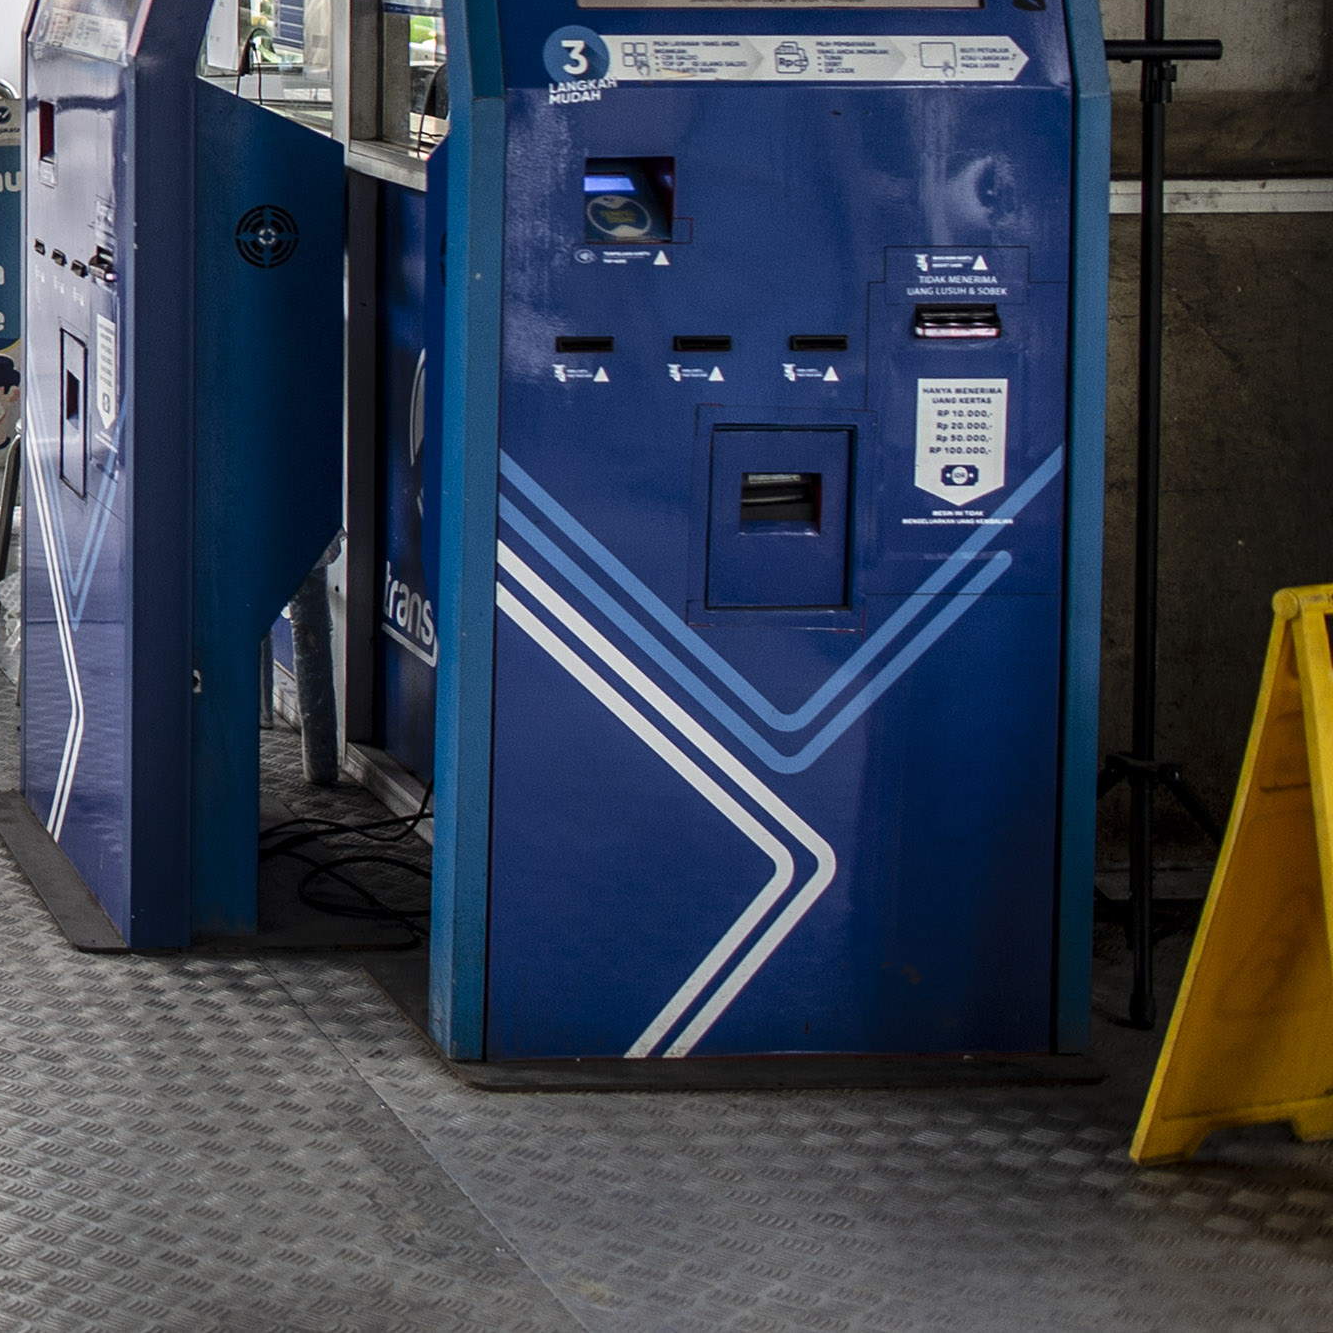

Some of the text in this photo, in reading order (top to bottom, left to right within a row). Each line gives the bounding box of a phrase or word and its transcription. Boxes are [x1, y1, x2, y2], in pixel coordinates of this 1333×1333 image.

[561, 40, 589, 75] 3
[548, 77, 618, 93] LANGKAH
[548, 90, 602, 104] MUDAH
[918, 275, 998, 284] TIDAK MENERIMA
[906, 287, 934, 295] UANG
[935, 287, 966, 295] LUSUH
[977, 287, 1008, 295] SOBEK
[936, 422, 949, 430] Rp
[936, 435, 948, 443] Rp
